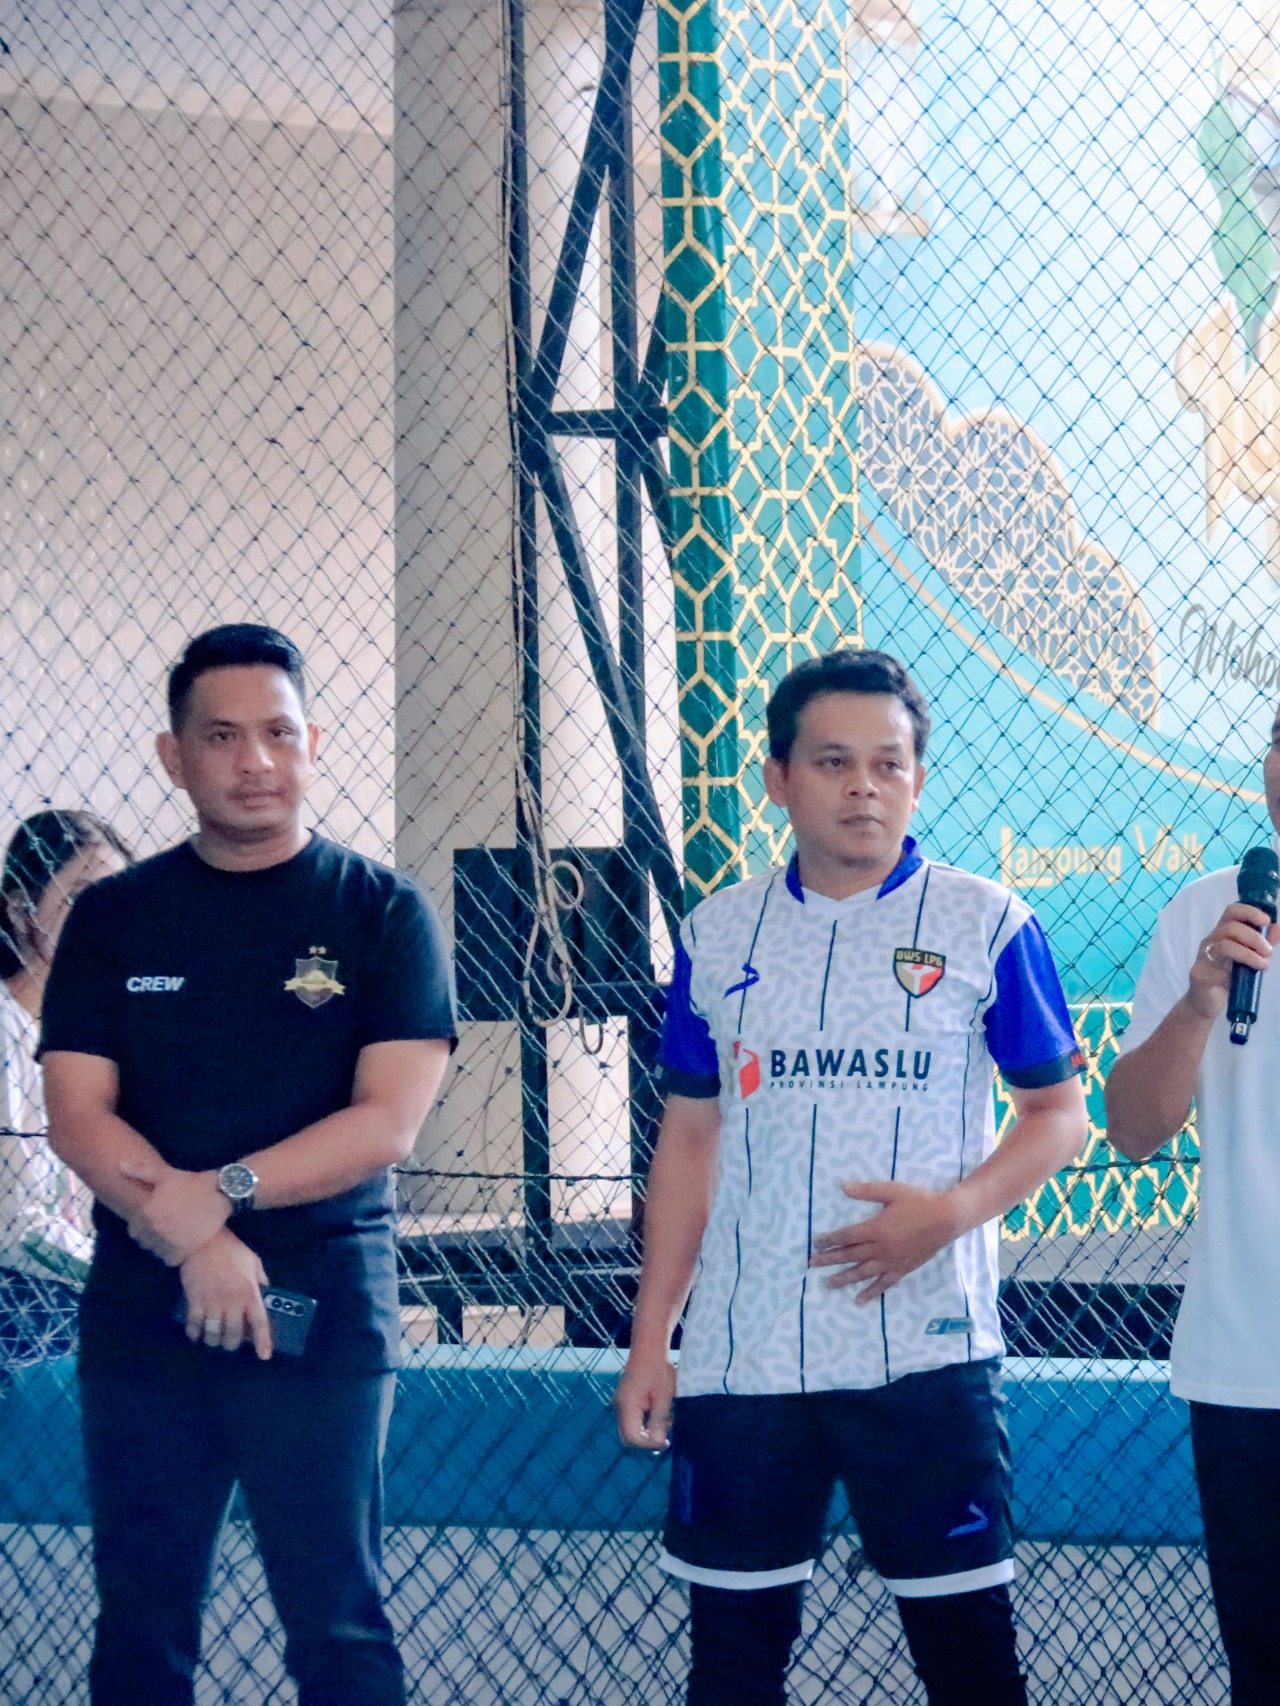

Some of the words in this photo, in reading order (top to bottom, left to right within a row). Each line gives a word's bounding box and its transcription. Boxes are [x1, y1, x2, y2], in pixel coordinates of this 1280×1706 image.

[1000, 826, 1122, 888] Lampung
[1133, 824, 1206, 874] Walk
[126, 976, 185, 993] CREW
[770, 1048, 932, 1080] BAWASLU
[769, 1080, 845, 1090] PROVINSI
[856, 1080, 929, 1092] LAMPUNG
